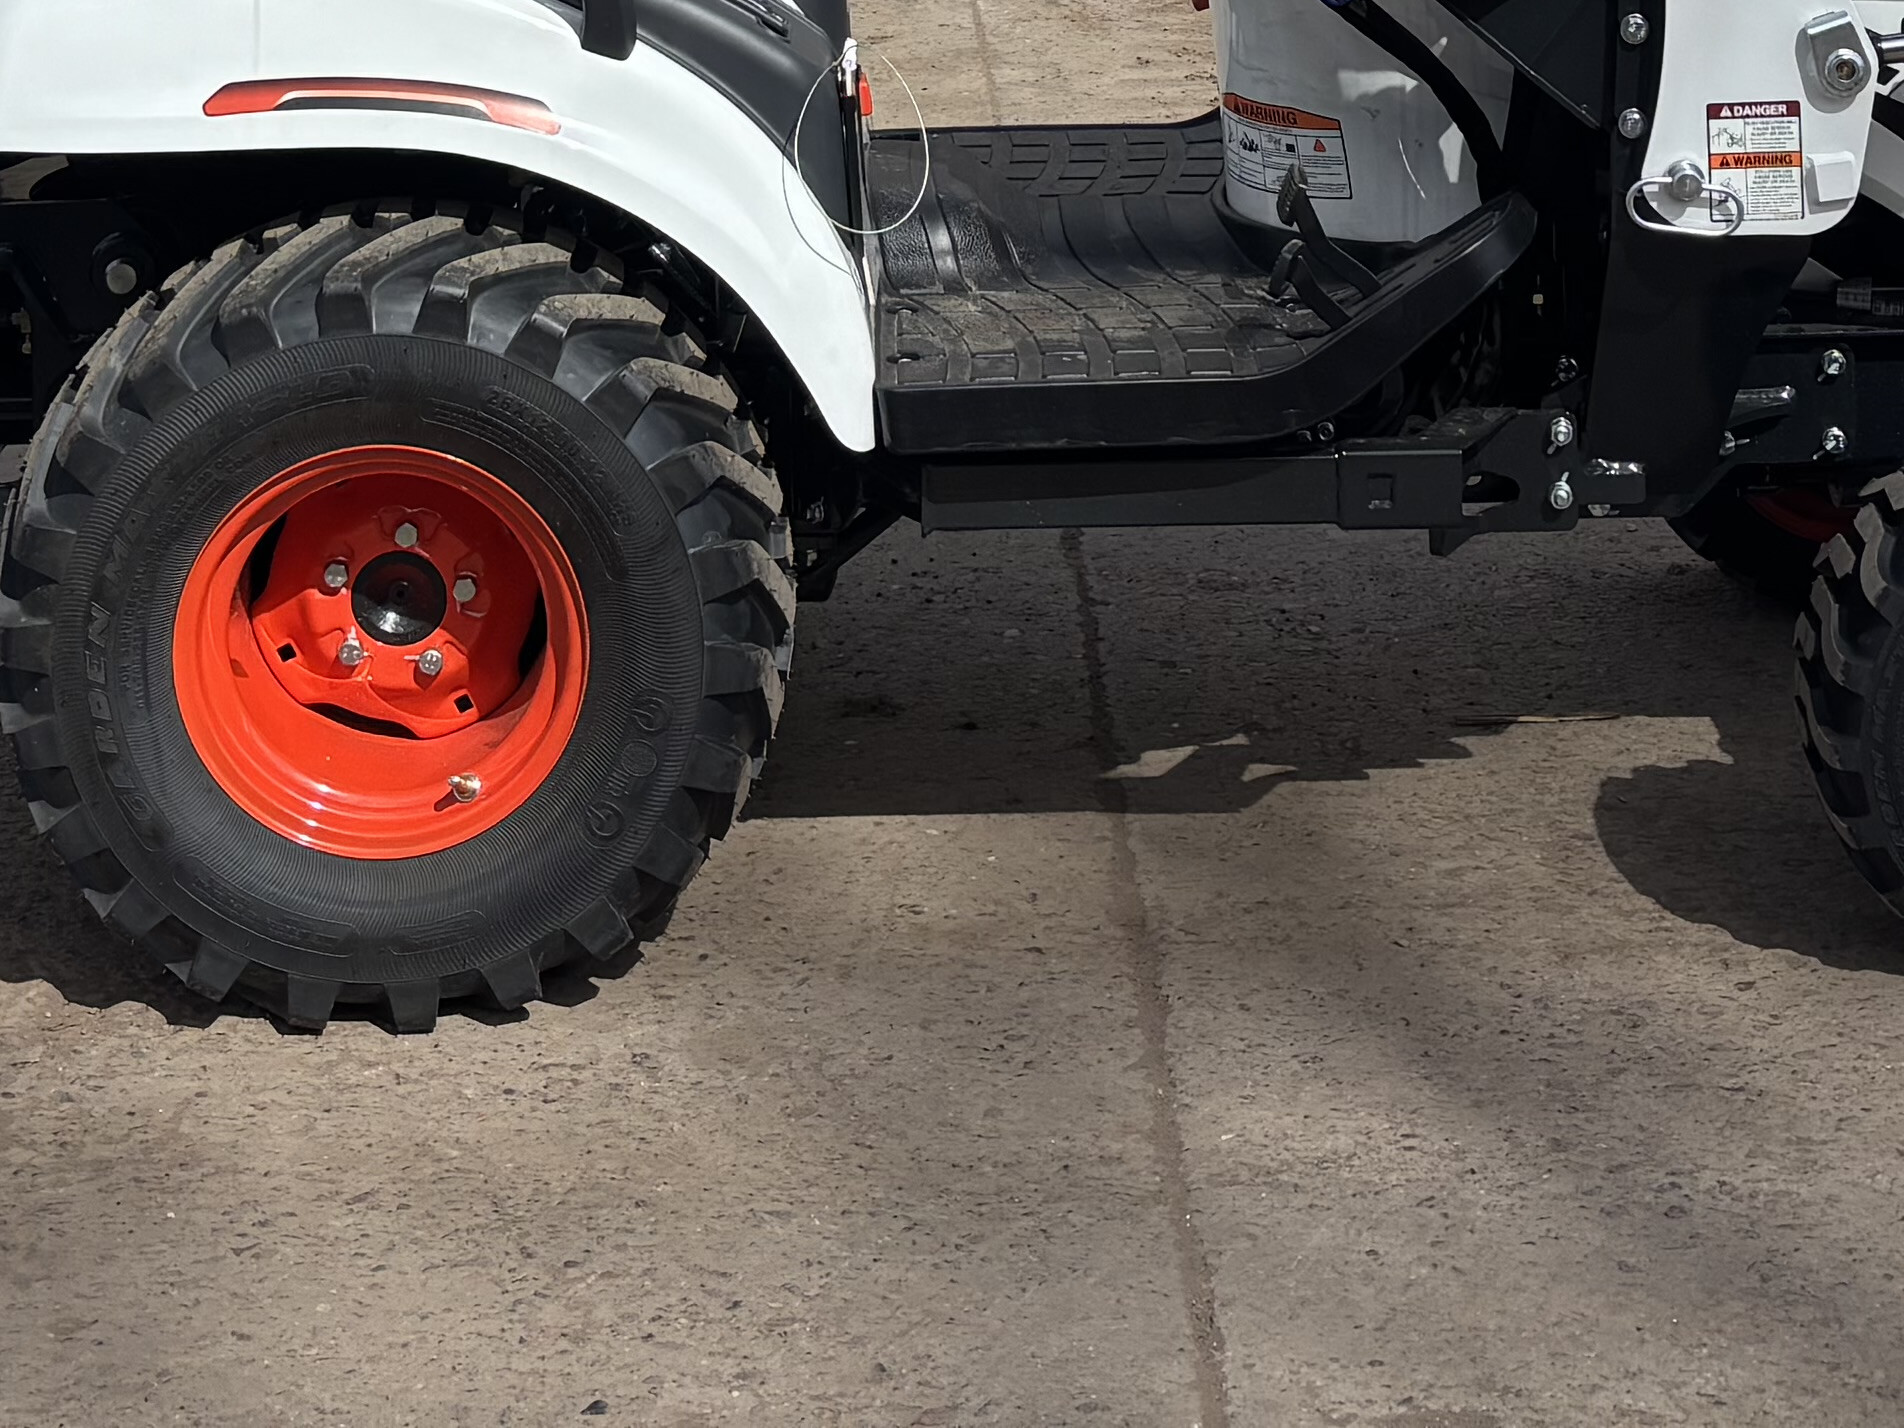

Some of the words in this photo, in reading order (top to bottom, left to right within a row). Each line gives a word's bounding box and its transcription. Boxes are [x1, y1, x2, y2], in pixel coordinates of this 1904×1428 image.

[1240, 101, 1297, 125] WARNING
[1733, 105, 1788, 117] DANGER
[1733, 154, 1793, 167] WARNING
